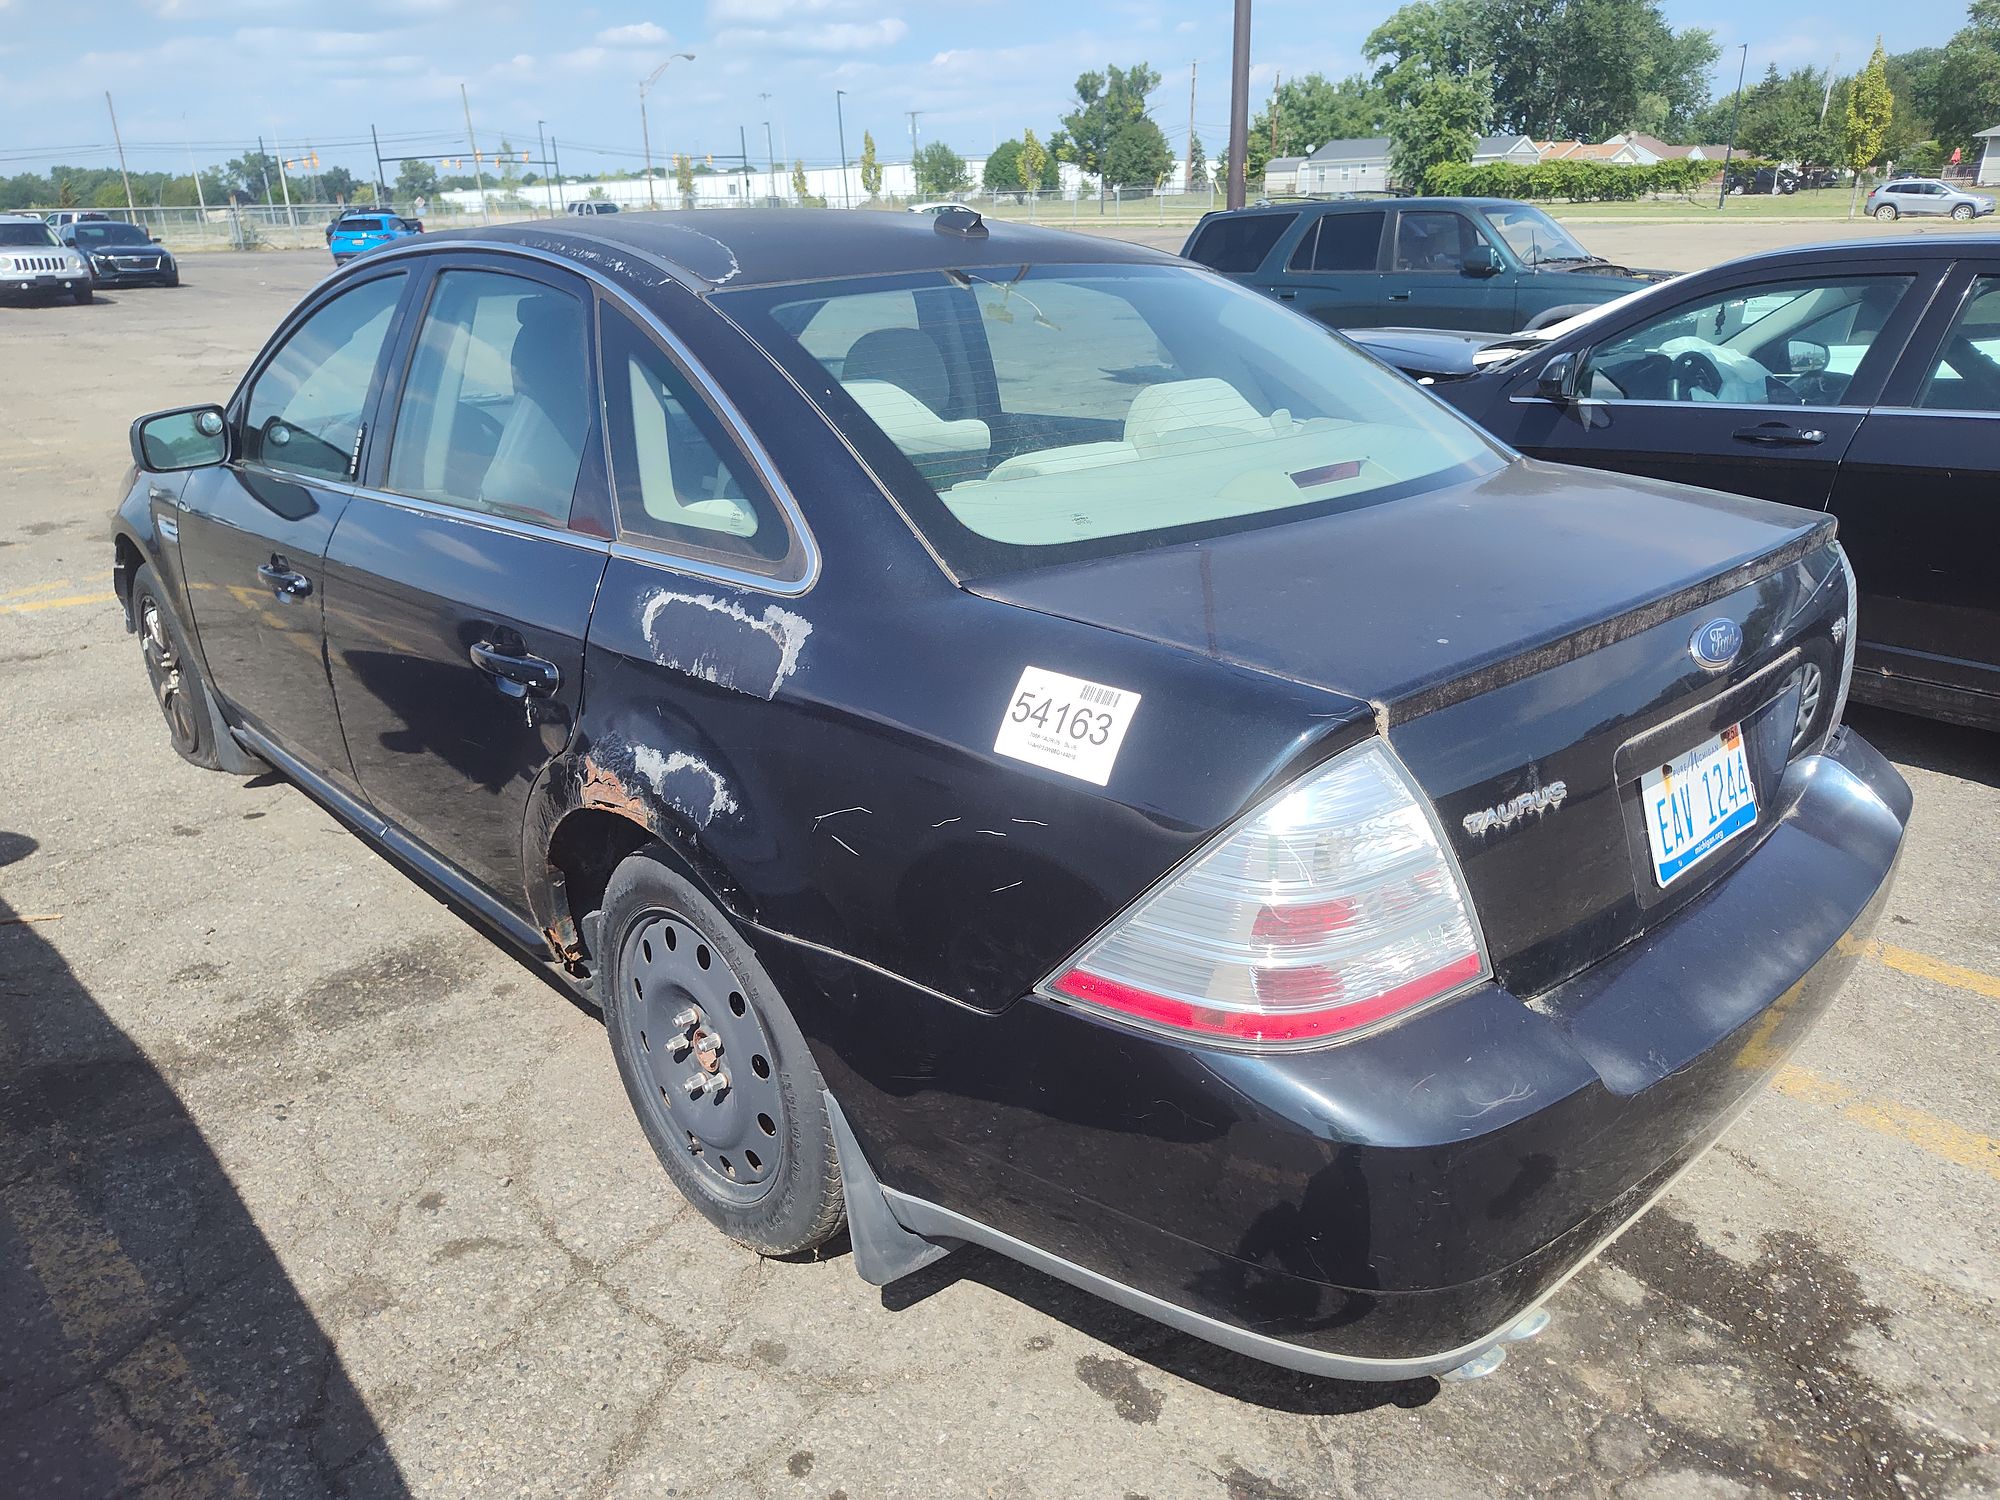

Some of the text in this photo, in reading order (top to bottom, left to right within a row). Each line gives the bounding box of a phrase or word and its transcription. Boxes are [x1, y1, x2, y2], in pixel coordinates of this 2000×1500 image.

[1709, 625, 1739, 656] Ford
[1011, 691, 1113, 746] 54163
[1672, 763, 1687, 777] PURE
[1463, 781, 1568, 834] TAURUS
[1656, 751, 1749, 857] EAV 1244
[1694, 829, 1724, 855] michigan.org
